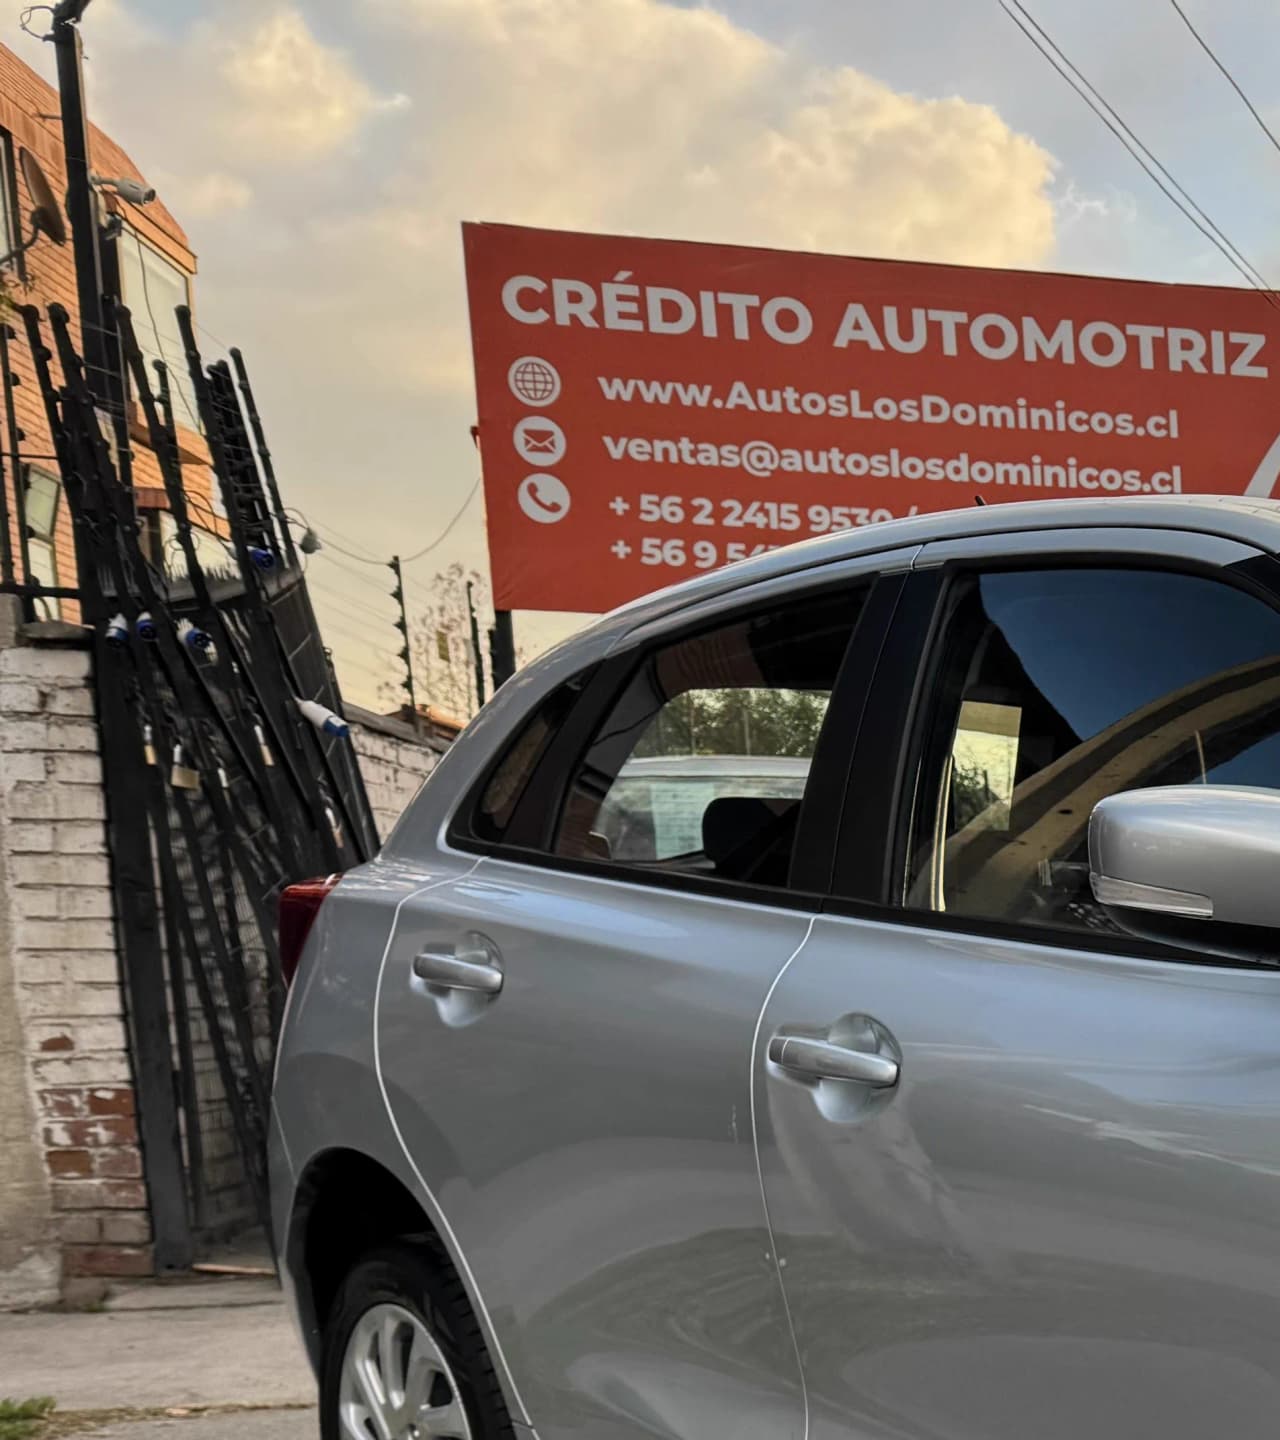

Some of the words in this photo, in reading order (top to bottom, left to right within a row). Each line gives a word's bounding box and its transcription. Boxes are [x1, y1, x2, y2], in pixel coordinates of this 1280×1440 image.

[501, 270, 814, 345] CRÉDITO
[832, 302, 1269, 378] AUTOMOTRIZ
[597, 376, 1180, 438] www.AutosLosDominicos.cl
[602, 435, 1183, 494] ventas@autoslosdominicos.cl
[639, 493, 685, 524] 56
[691, 498, 715, 526] 2
[720, 499, 802, 530] 2415
[640, 537, 688, 567] 56
[693, 540, 718, 568] 9
